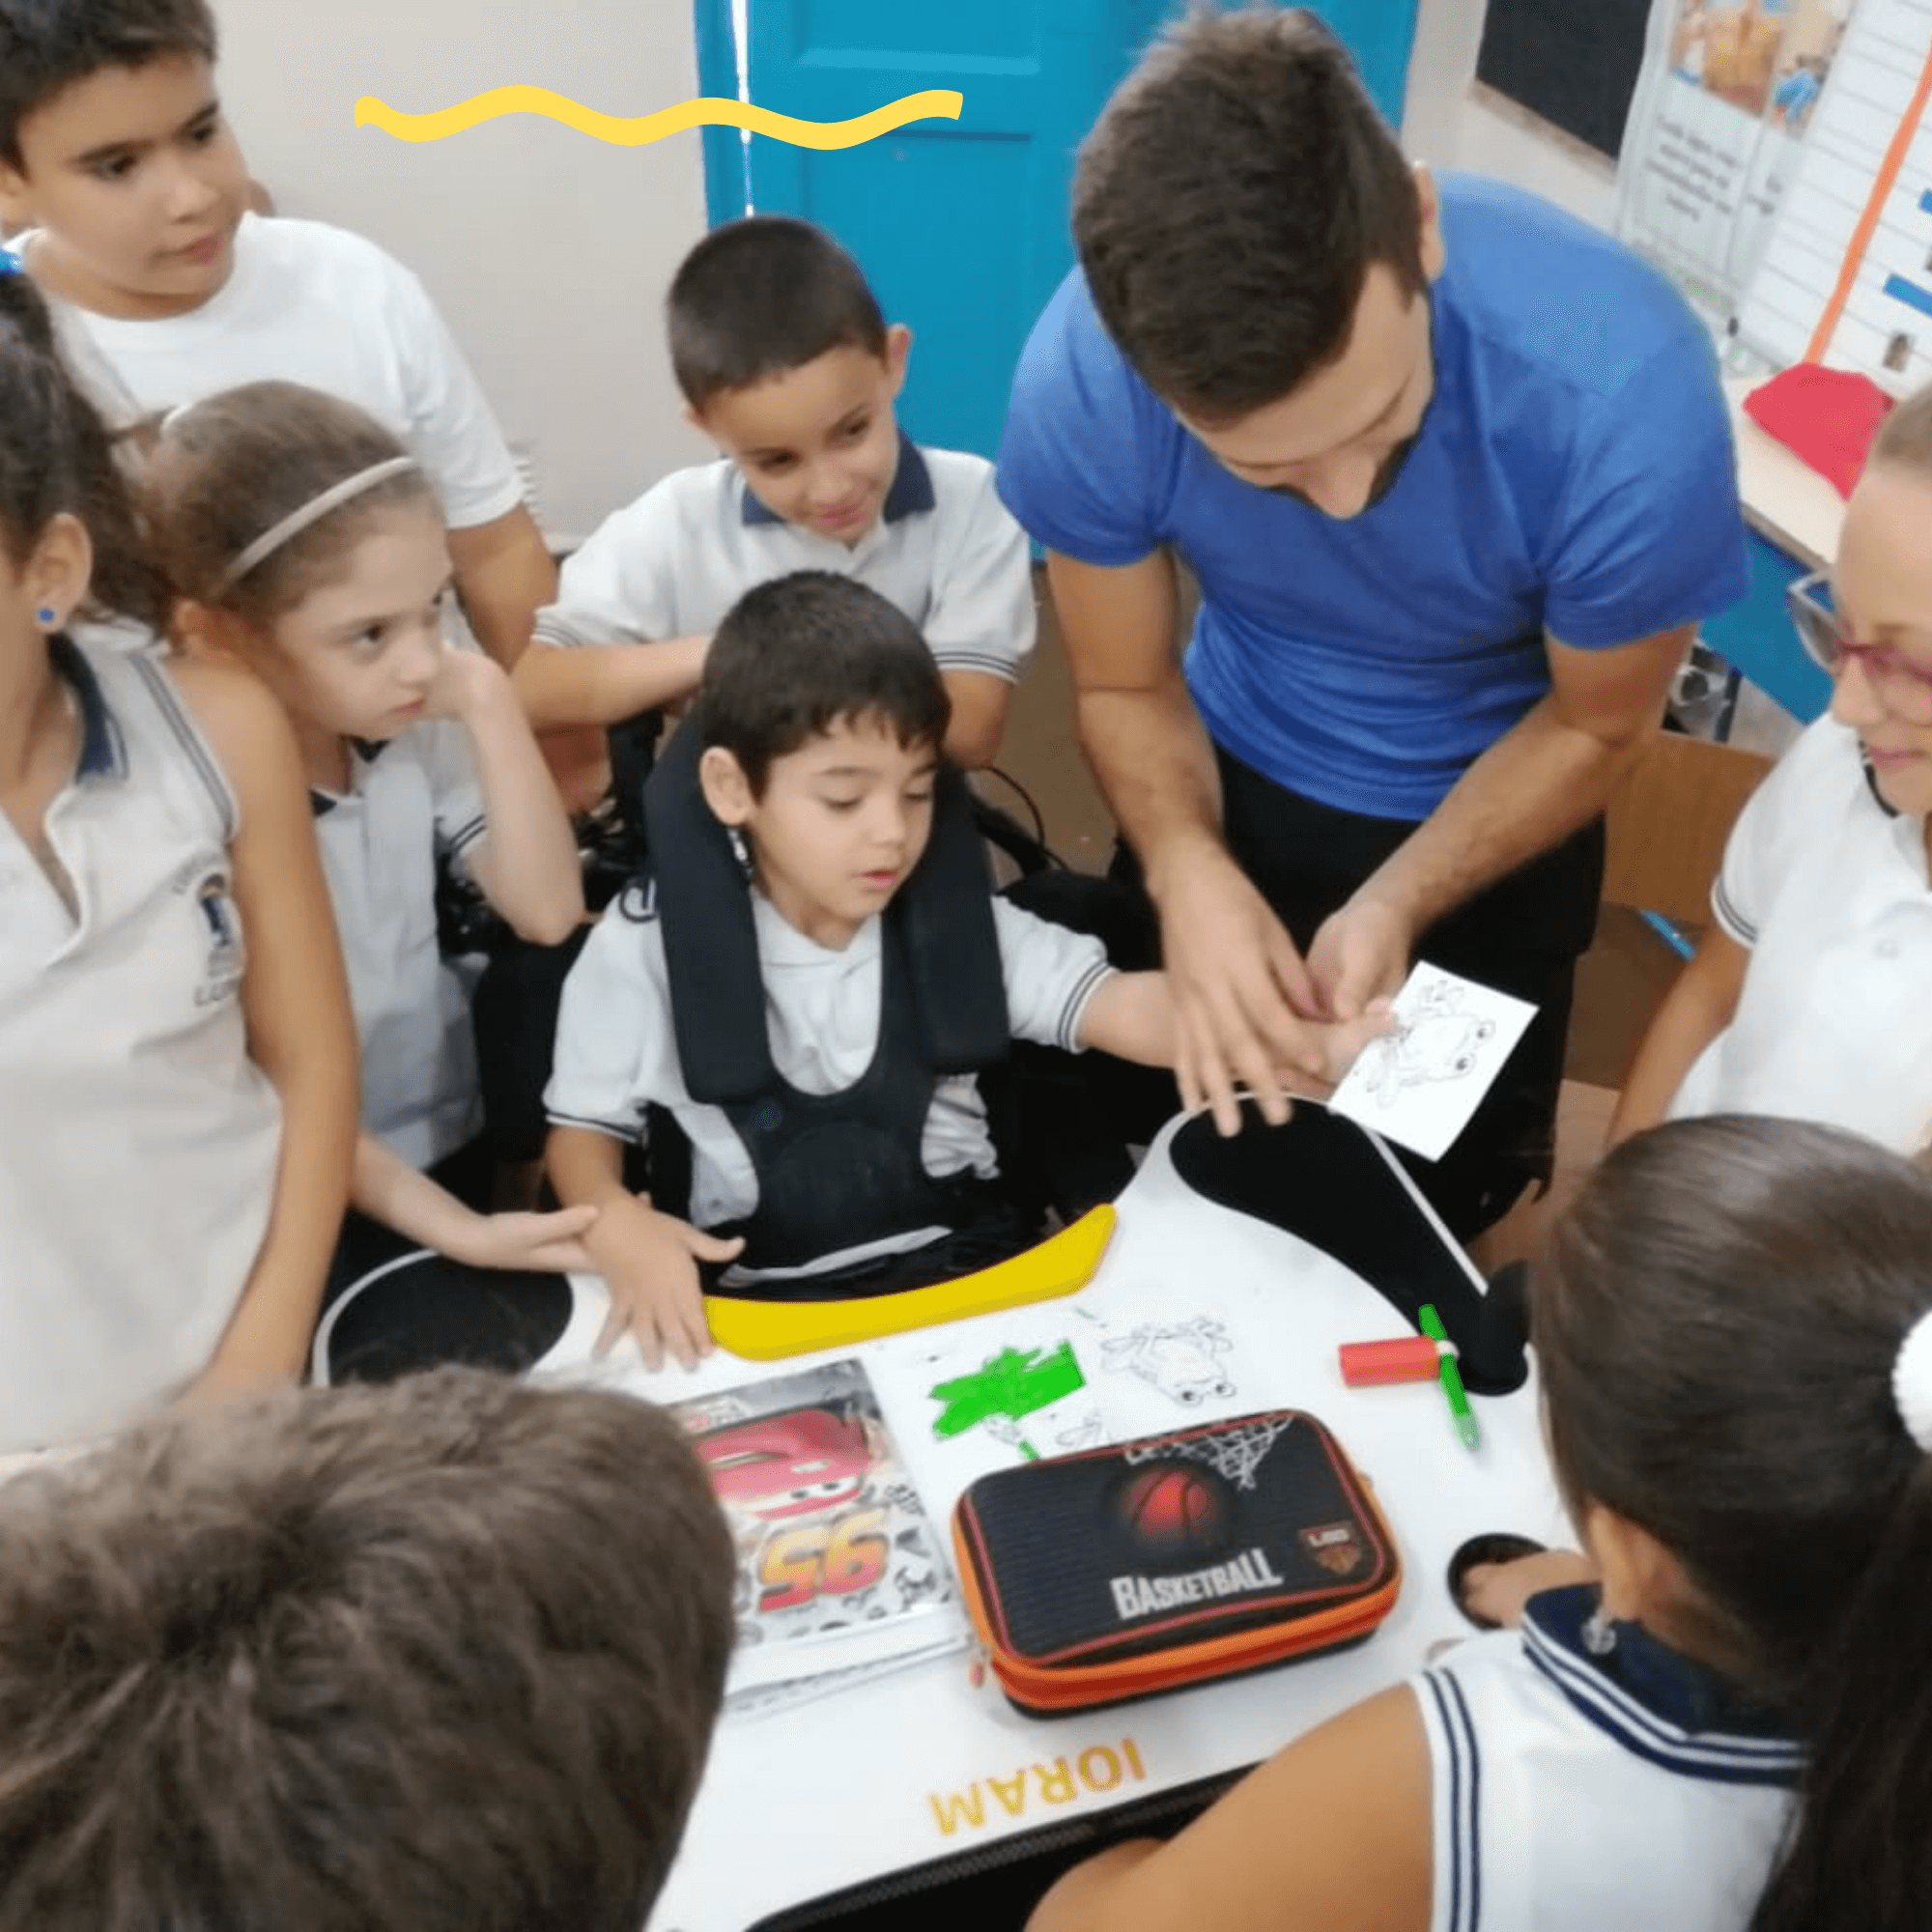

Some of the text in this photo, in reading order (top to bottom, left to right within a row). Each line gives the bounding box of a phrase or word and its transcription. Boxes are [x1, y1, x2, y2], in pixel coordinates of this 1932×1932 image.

[757, 1508, 890, 1612] 95
[1110, 1548, 1284, 1620] BASKETBALL
[927, 1738, 1147, 1835] IORAM
